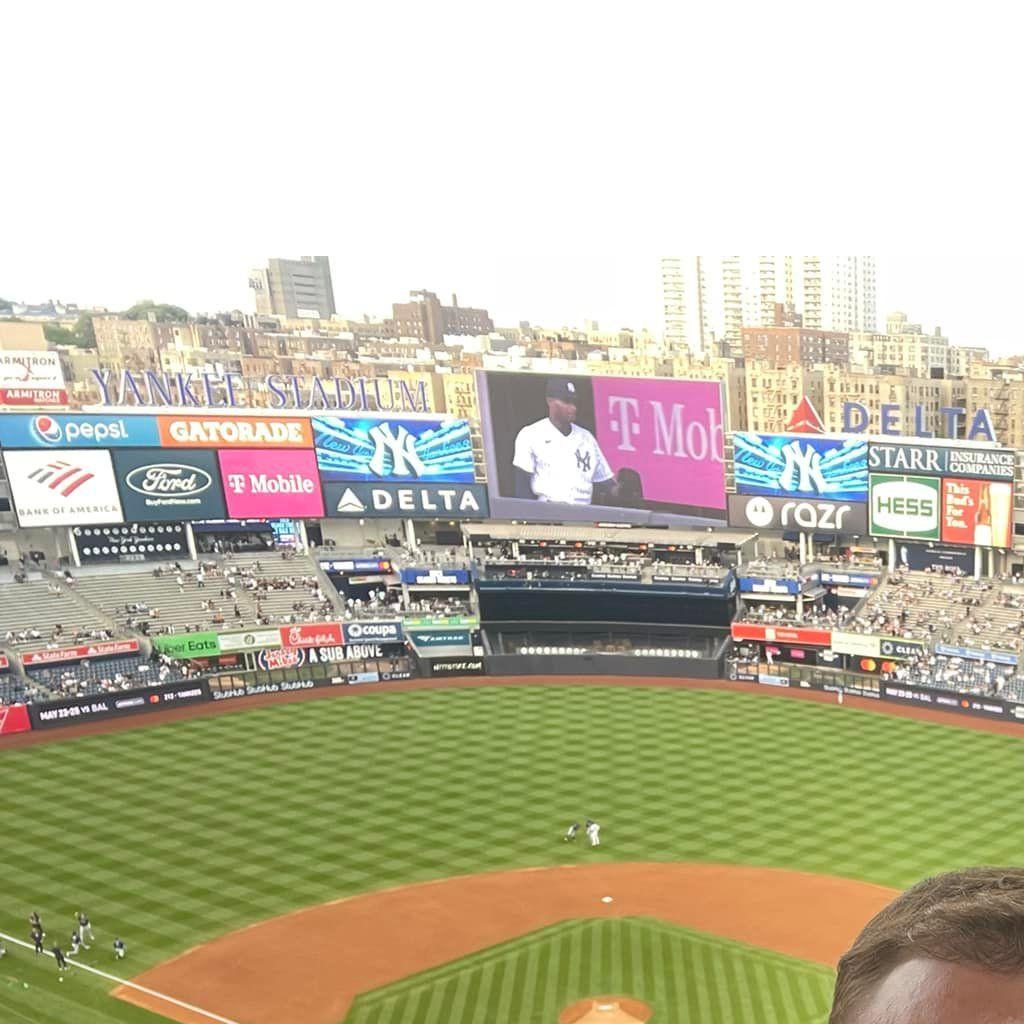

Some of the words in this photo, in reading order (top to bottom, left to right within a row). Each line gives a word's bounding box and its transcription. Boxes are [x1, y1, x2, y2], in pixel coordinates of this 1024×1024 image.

[6, 389, 60, 400] ARMITRON
[92, 367, 242, 408] YANKEE
[265, 374, 431, 412] STADIUM
[843, 402, 997, 442] DELTA
[65, 420, 128, 443] pepsi
[169, 420, 303, 443] GATORADE
[868, 446, 942, 471] STARR
[950, 452, 1014, 467] INSURANCE
[949, 462, 1014, 476] COMPANIES
[142, 469, 197, 492] Ford
[250, 475, 314, 493] Mobile
[946, 482, 970, 495] This
[372, 489, 480, 511] DELTA
[877, 497, 934, 516] HESS
[946, 494, 974, 506] Bud's
[19, 508, 49, 517] BANK
[52, 506, 65, 516] OF
[68, 505, 119, 515] AMERICA
[781, 502, 851, 529] razr
[946, 505, 965, 517] For
[363, 624, 397, 636] coupa
[188, 640, 217, 651] Eats
[309, 648, 318, 663] A
[320, 646, 345, 662] SUB
[346, 644, 383, 659] ABOVE
